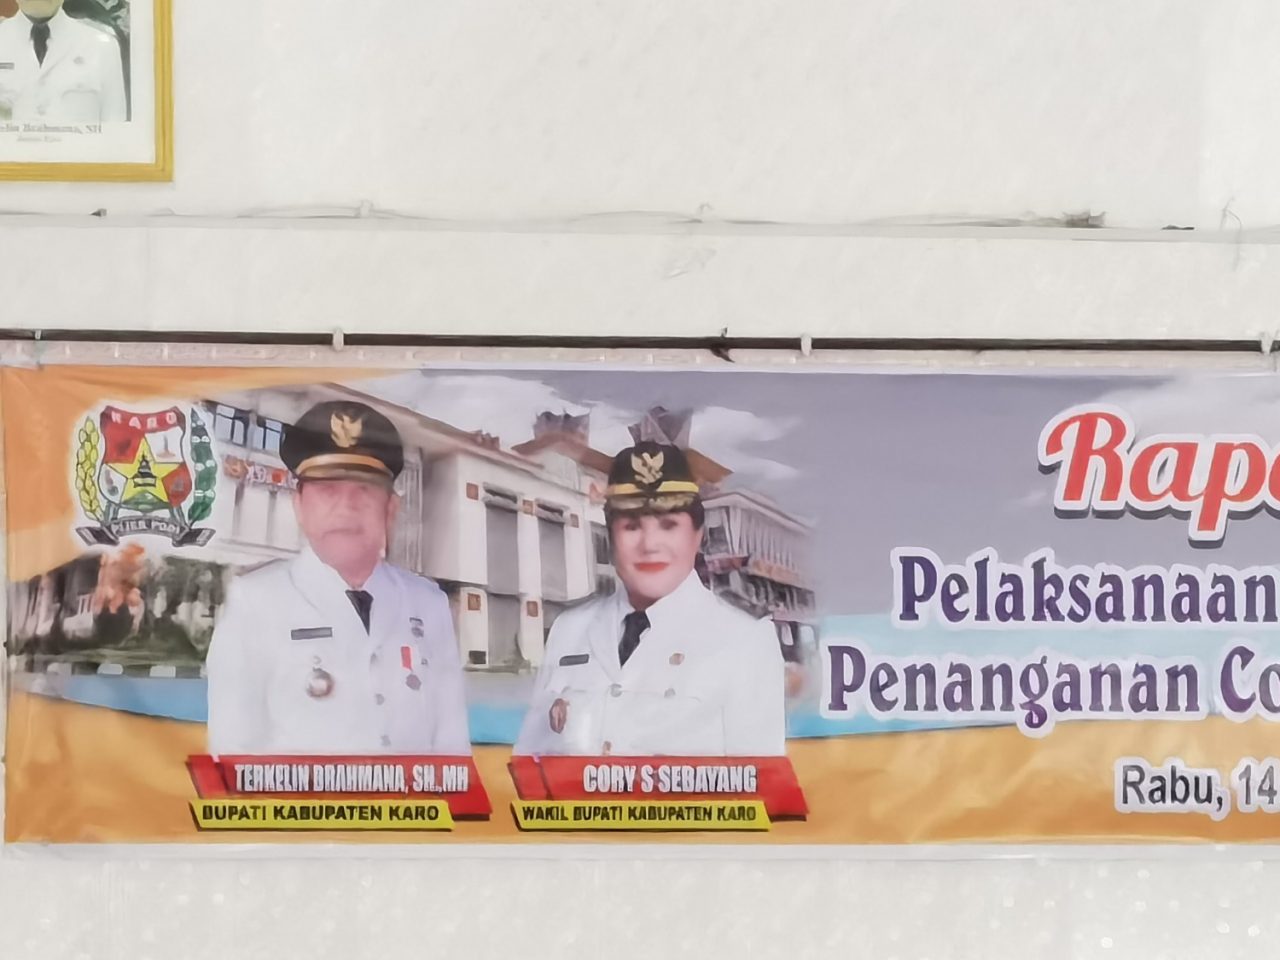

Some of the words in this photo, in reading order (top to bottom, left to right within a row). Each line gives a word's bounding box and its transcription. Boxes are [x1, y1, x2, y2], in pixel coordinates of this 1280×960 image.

[898, 554, 1279, 624] Pelaksanaan
[827, 644, 1201, 730] Penanganan
[234, 763, 310, 793] TERKELIN
[313, 763, 408, 794] BRAHMANA,
[582, 764, 637, 793] CORY
[640, 764, 654, 793] S
[657, 764, 758, 793] SEBAYANG
[1121, 763, 1224, 812] Rabu,
[1237, 764, 1278, 806] 14
[201, 804, 267, 821] BUPATI
[272, 804, 383, 822] KABUPATEN
[388, 804, 440, 821] KARO
[521, 805, 569, 822] WAKIL
[572, 805, 623, 822] BUPATI
[627, 805, 712, 822] KABUPATEN
[716, 805, 757, 822] KARO
